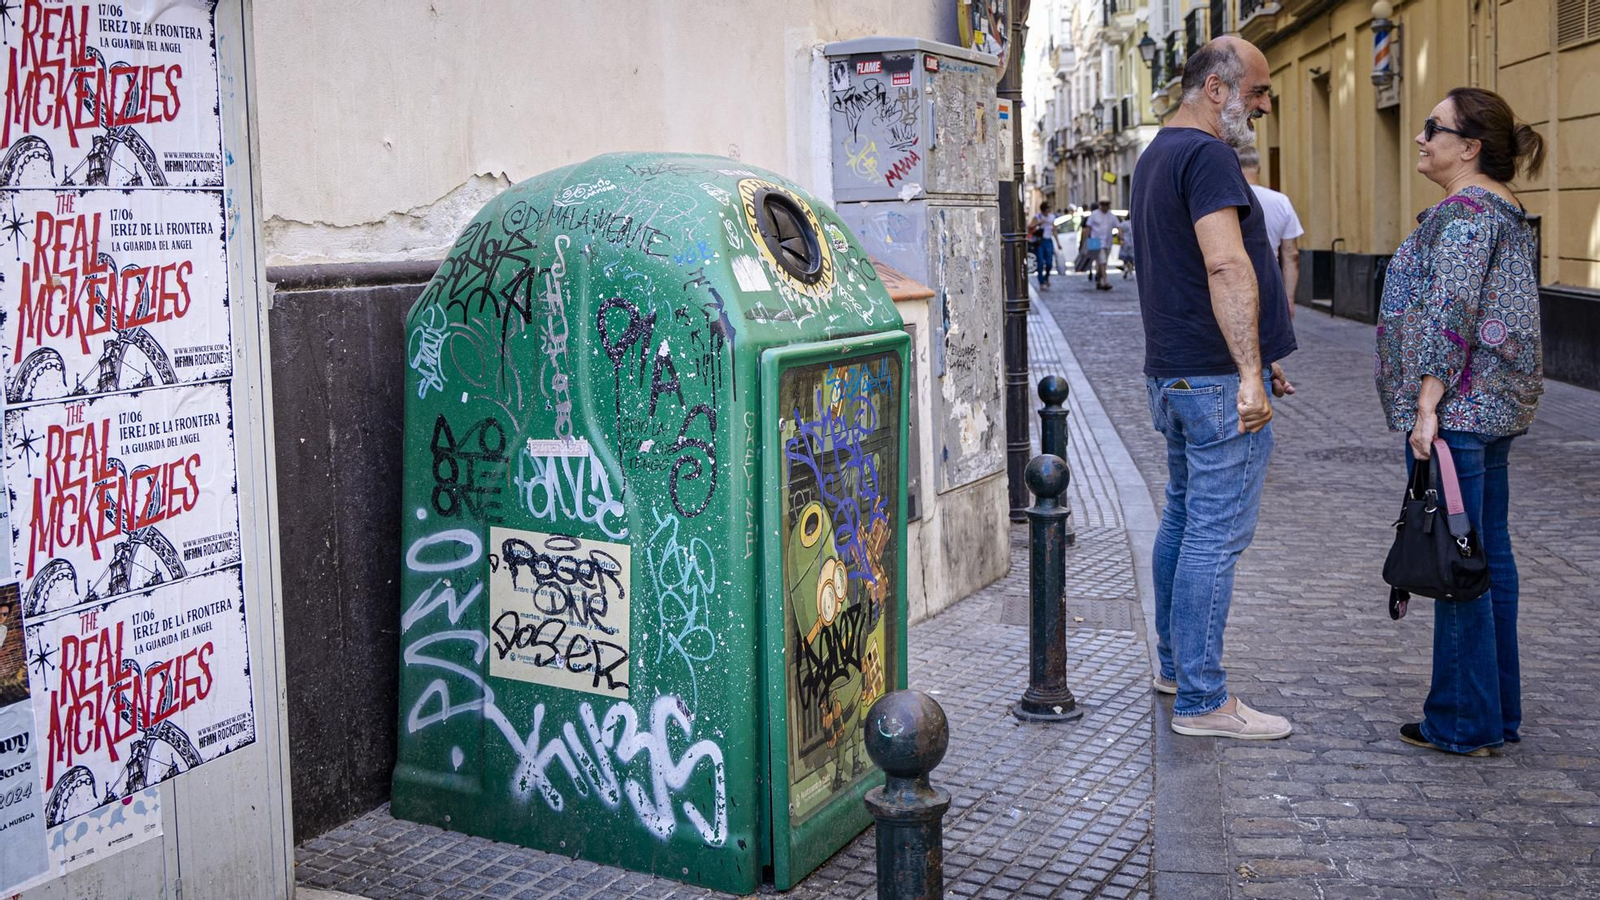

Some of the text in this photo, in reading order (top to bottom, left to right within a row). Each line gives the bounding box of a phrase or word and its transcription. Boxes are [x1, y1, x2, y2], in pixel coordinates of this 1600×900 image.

[98, 4, 123, 17] 17/06
[21, 0, 96, 80] REAL
[98, 18, 203, 40] JEREZ DE LA FRONTERA
[100, 37, 110, 48] LA
[112, 38, 145, 51] GUARIDA
[160, 41, 182, 54] ANGEL
[856, 61, 881, 73] FLAME
[164, 160, 215, 172] HFMN ROCKZONE
[56, 194, 76, 215] THE
[110, 209, 133, 221] 17/06
[110, 222, 214, 238] JEREZ DE LA FRONTERA
[33, 211, 109, 284] REAL
[112, 240, 193, 252] LA GUARIDA DEL ANGEL
[174, 352, 224, 368] HFMN ROCKZONE
[65, 404, 85, 426] THE
[118, 410, 142, 425] 17/06
[120, 412, 221, 441] JEREZ DE LA FRONTERA
[120, 432, 201, 456] LA GUARIDA DEL ANGEL
[46, 418, 117, 497] REAL
[184, 538, 232, 562] HFMN ROCKZONE
[80, 611, 99, 635] THE
[132, 608, 156, 626] 17/06
[133, 621, 160, 642] JEREZ
[162, 617, 173, 632] DE
[186, 598, 233, 623] FRONTERA
[134, 644, 144, 656] LA
[146, 632, 179, 652] GUARIDA
[192, 620, 213, 637] ANGEL
[60, 621, 132, 707] REAL
[198, 720, 247, 749] HFMN ROCKZONE
[9, 812, 35, 828] MUSICA
